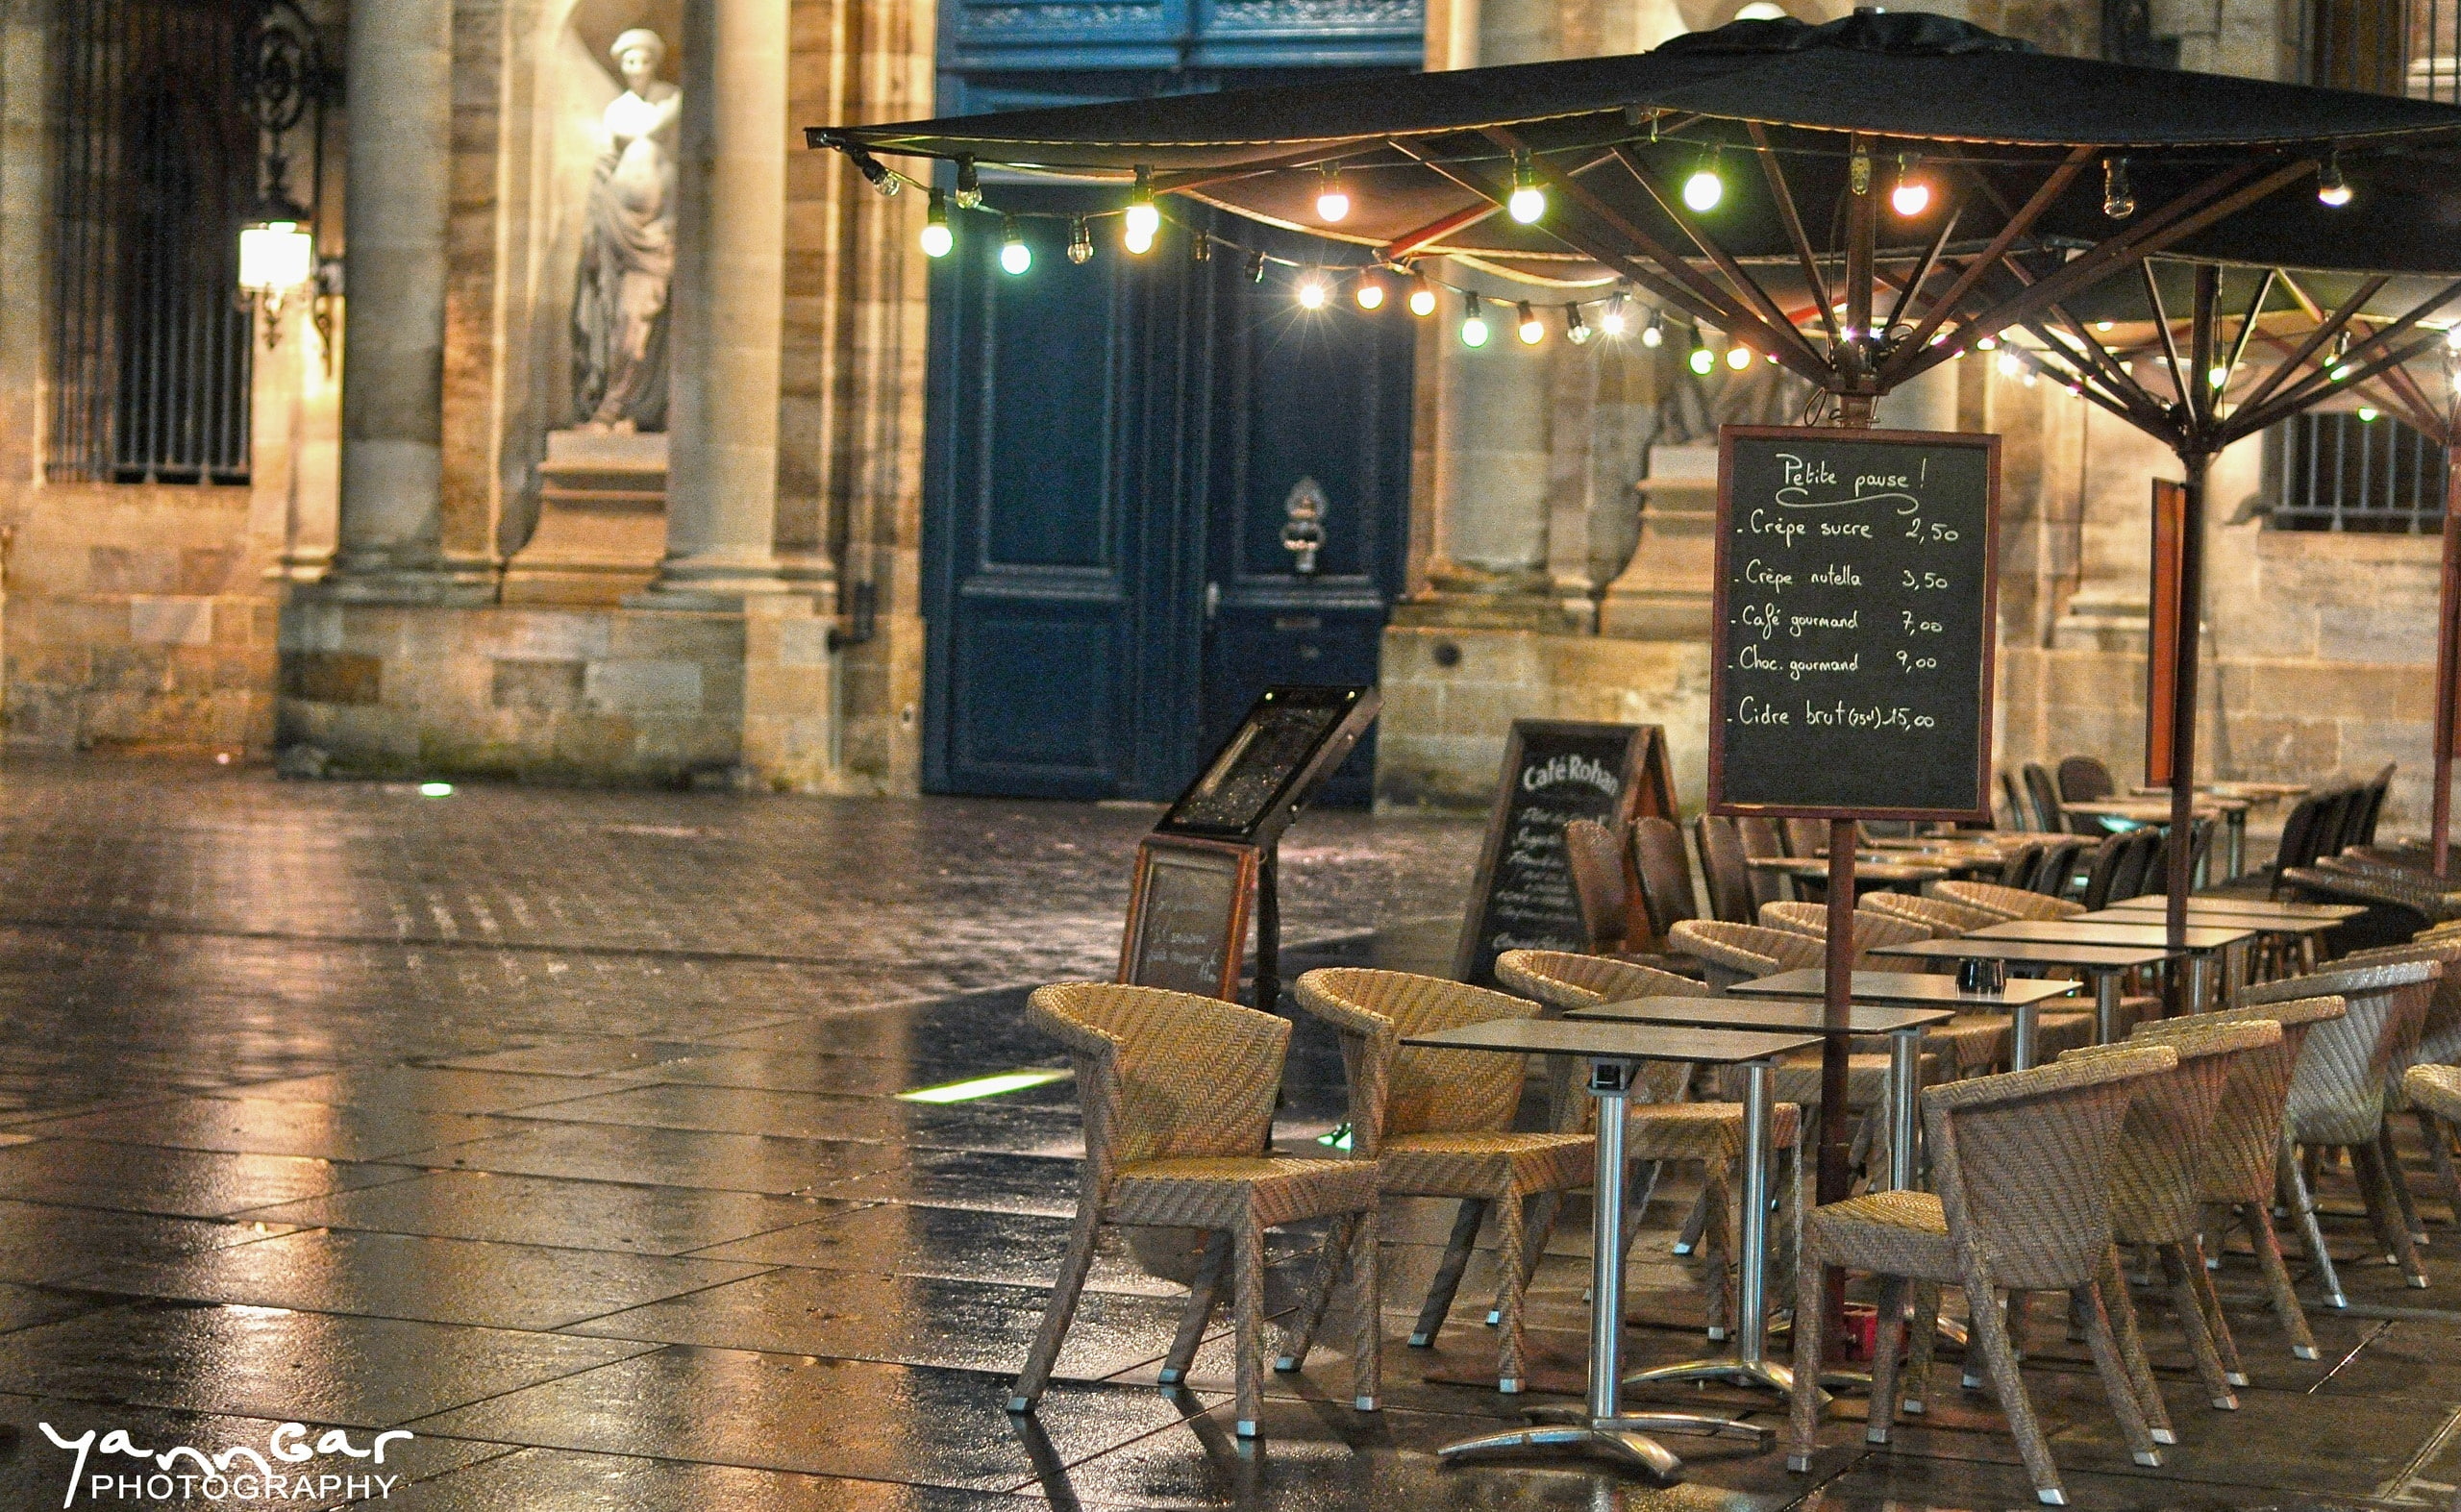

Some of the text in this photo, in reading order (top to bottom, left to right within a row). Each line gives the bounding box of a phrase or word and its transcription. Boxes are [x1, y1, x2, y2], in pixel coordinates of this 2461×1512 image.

[1776, 453, 1838, 485] Petite
[1853, 474, 1910, 498] pause
[1821, 522, 1874, 539] sucre
[1904, 517, 1959, 545] 2,50
[1810, 563, 1862, 586] nutella
[1902, 569, 1949, 591] 3,50
[1742, 602, 1943, 640] Café gourmand 7,00
[1738, 644, 1938, 681] Choc. gourmand 9,00
[1738, 695, 1791, 725] Cidre
[1805, 699, 1846, 726] brut
